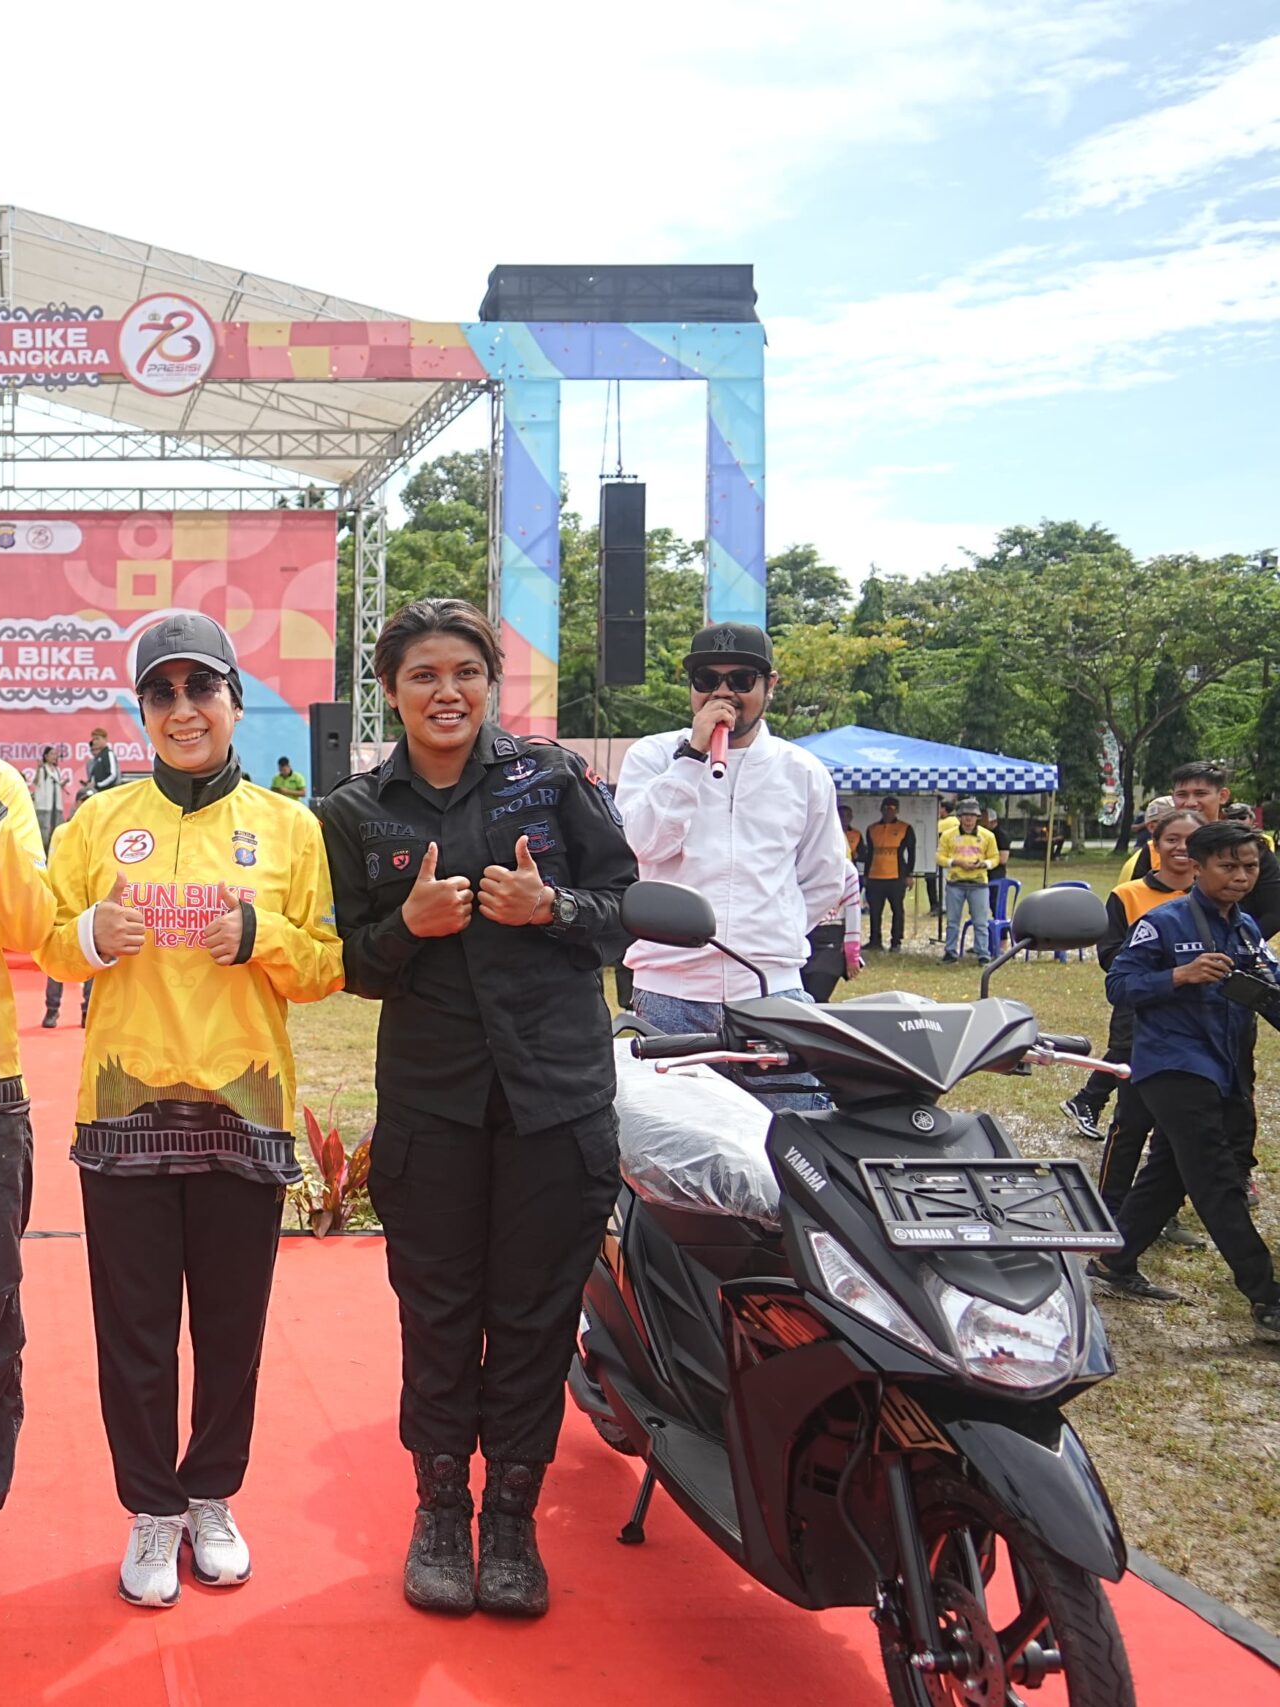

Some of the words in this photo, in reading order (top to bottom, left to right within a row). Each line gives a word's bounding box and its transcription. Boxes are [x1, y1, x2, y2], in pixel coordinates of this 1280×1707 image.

[12, 327, 88, 349] BIKE
[17, 646, 95, 666] BIKE
[489, 787, 561, 822] POLRI
[897, 1018, 944, 1033] YAMAHA
[783, 1145, 828, 1193] YAMAHA
[906, 1228, 955, 1241] YAMAHA
